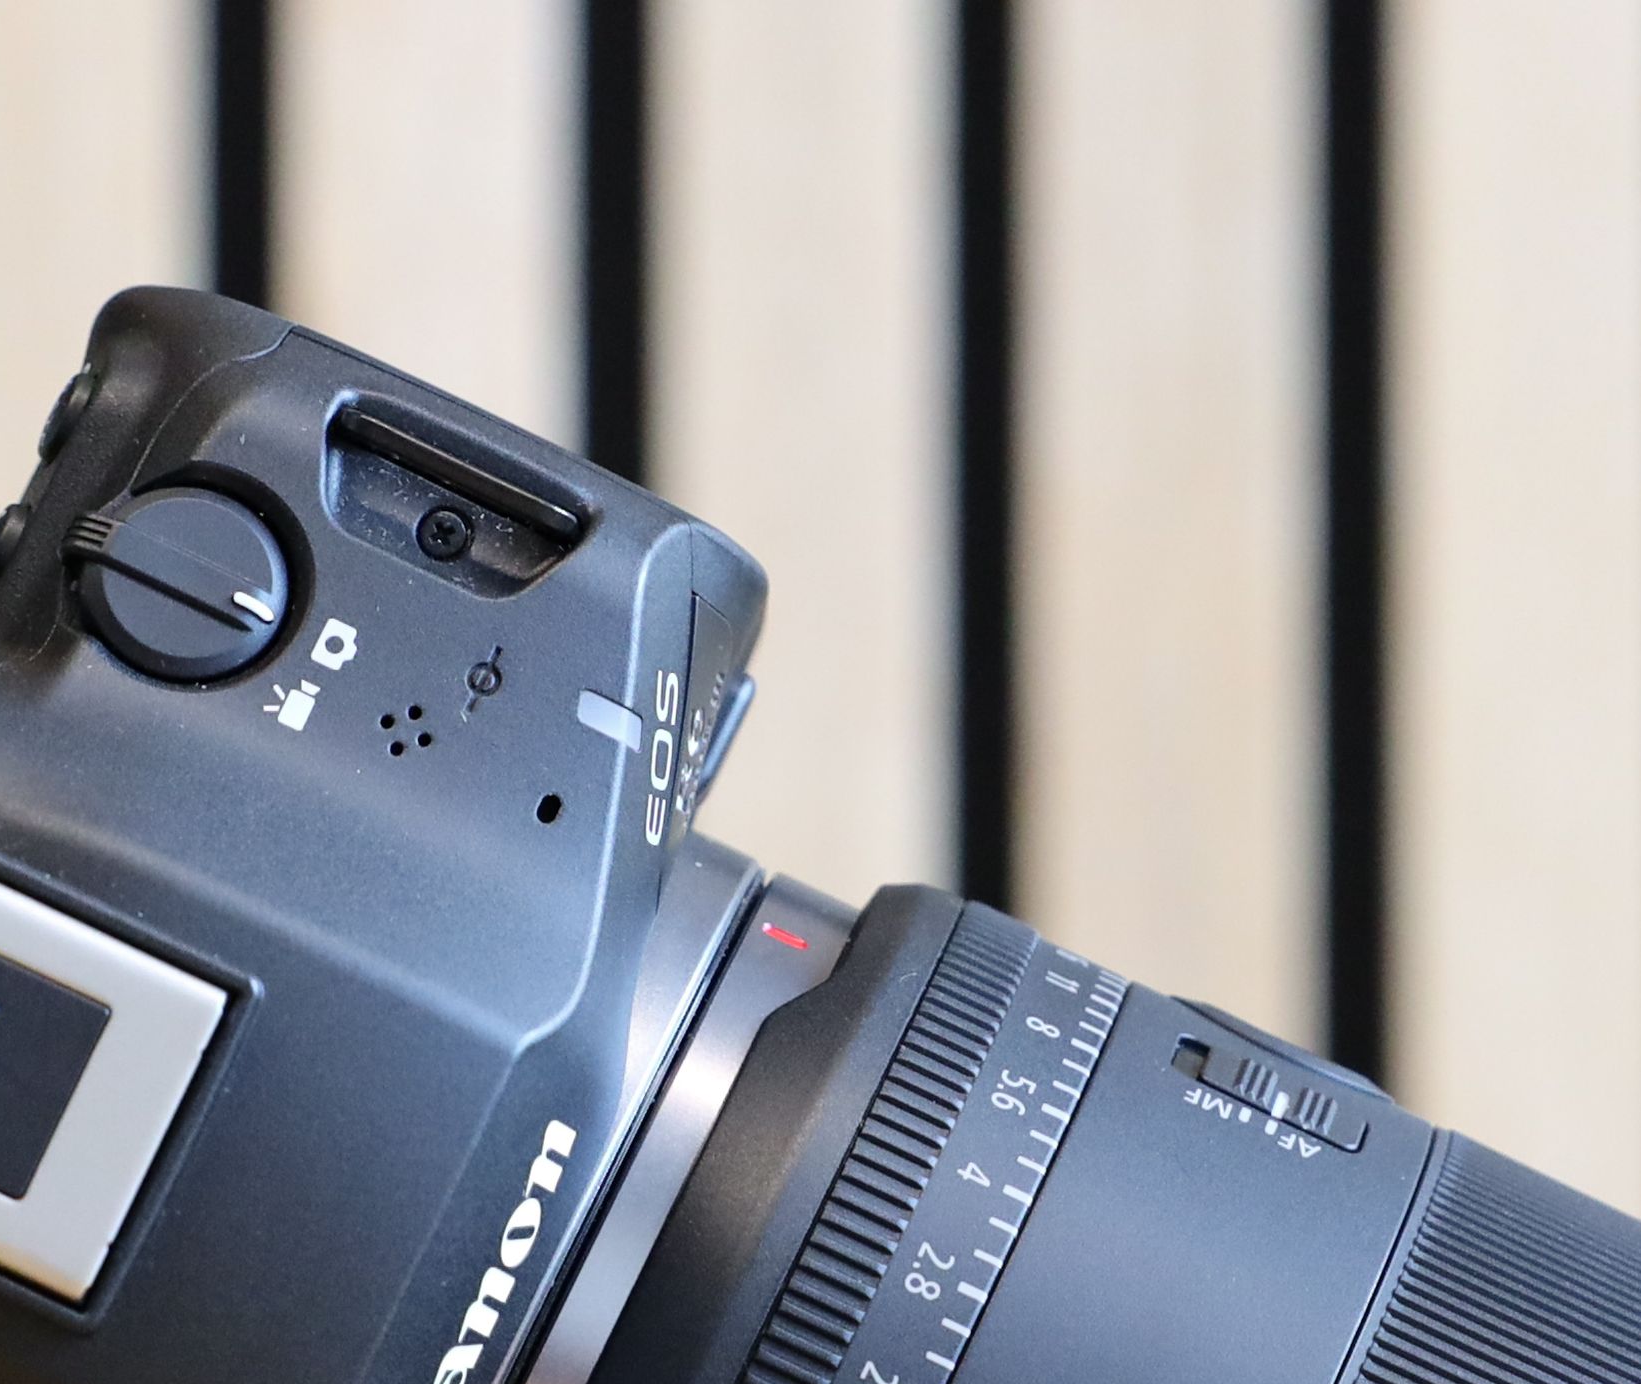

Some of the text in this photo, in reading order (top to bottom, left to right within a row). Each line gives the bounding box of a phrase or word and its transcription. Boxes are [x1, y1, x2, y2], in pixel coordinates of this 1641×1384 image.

[645, 669, 679, 846] EOS
[1025, 1016, 1061, 1039] 8
[990, 1069, 1038, 1117] 5.6
[1183, 1088, 1233, 1120] MF
[1276, 1133, 1322, 1158] AF
[956, 1162, 991, 1188] 4
[904, 1241, 956, 1301] 2.8
